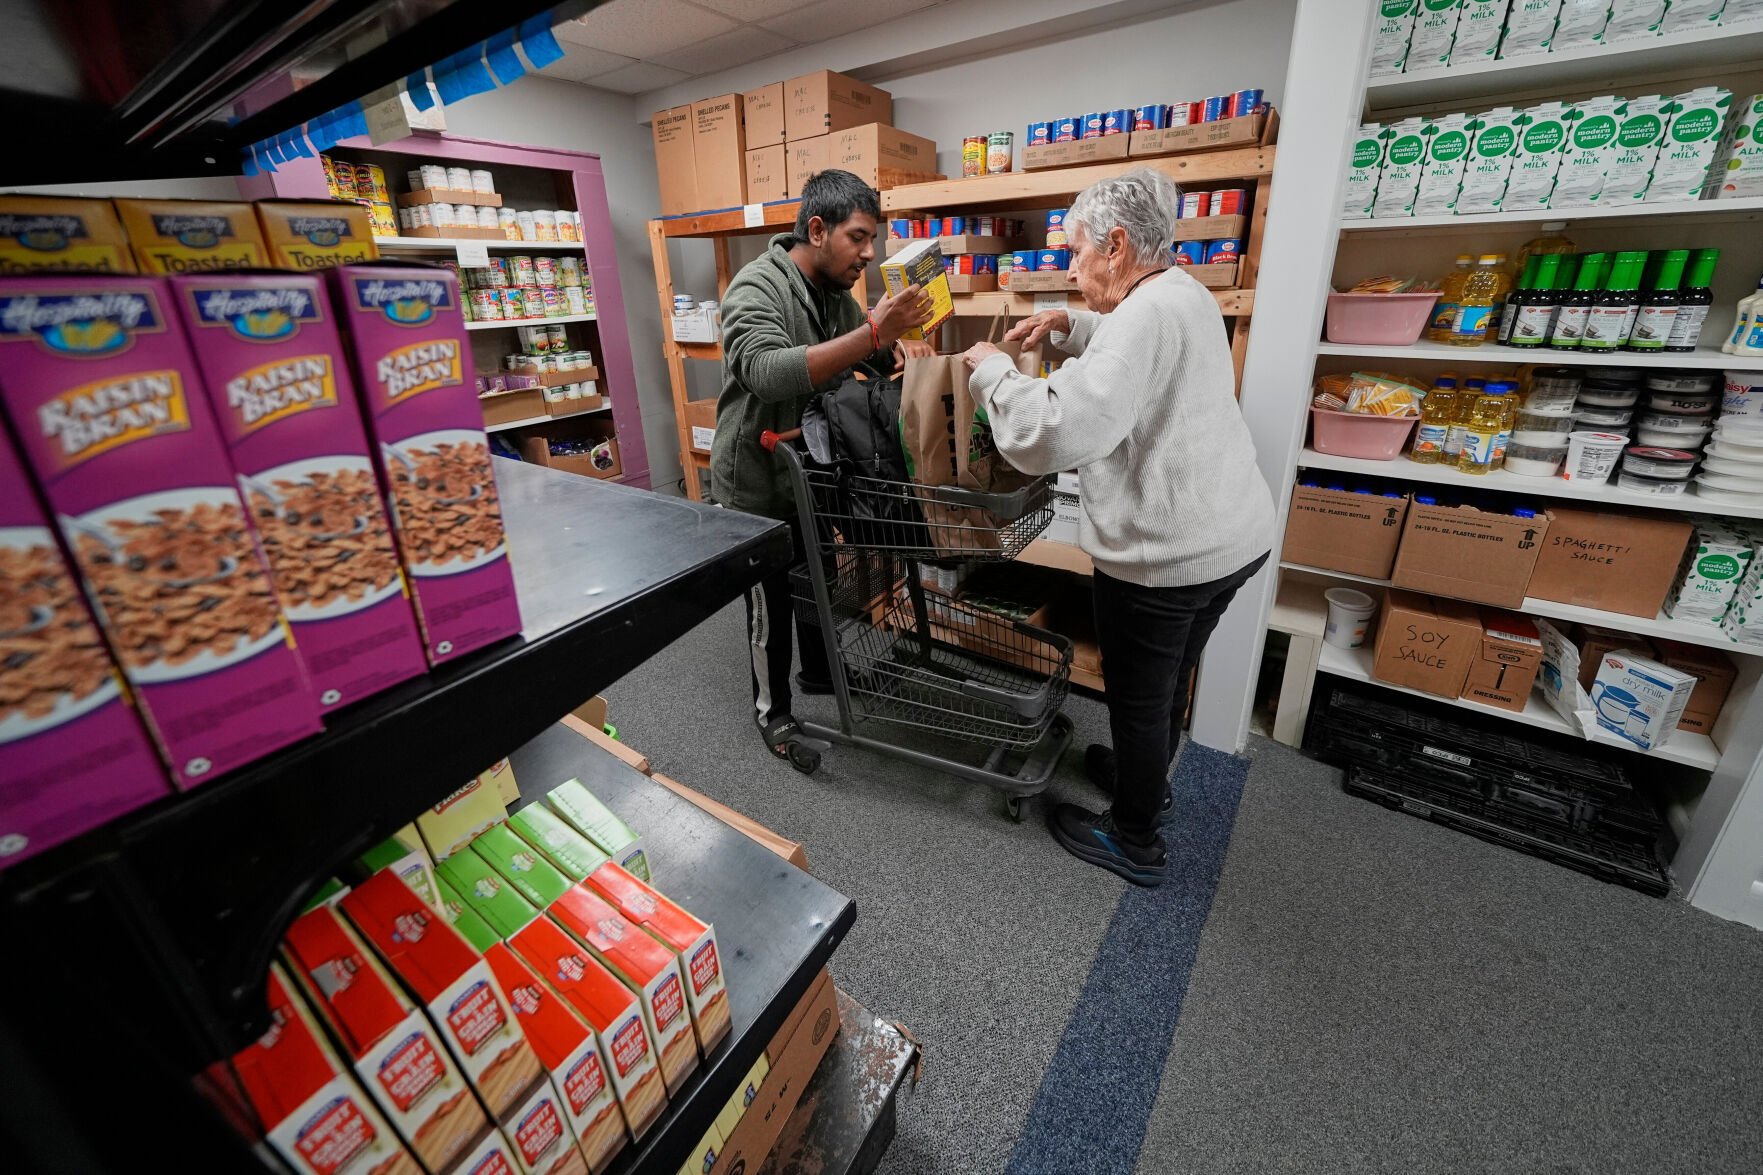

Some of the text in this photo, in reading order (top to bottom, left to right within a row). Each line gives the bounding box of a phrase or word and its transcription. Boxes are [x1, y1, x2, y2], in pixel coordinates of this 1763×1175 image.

[1524, 1, 1550, 10] MILK
[1470, 10, 1496, 20] MILK
[1380, 25, 1402, 34] MILK
[1424, 19, 1448, 28] MILK
[795, 88, 807, 96] MAC
[698, 103, 730, 116] SHELLED PECANS
[1527, 132, 1558, 141] modern
[1679, 127, 1712, 135] pantry
[841, 134, 857, 144] MAC
[1480, 137, 1510, 146] modern
[1483, 142, 1510, 150] pantry
[1530, 138, 1559, 147] pantry
[797, 150, 810, 160] MAC
[1395, 150, 1418, 159] pantry
[1437, 146, 1463, 155] pantry
[1671, 150, 1700, 159] MILK
[842, 154, 861, 164] CHEESE
[1523, 160, 1549, 168] MILK
[1573, 157, 1600, 165] MILK
[1617, 155, 1644, 164] MILK
[1431, 168, 1454, 176] MILK
[1476, 164, 1501, 172] MILK
[1350, 174, 1370, 182] MILK
[1390, 171, 1411, 180] MILK
[154, 252, 254, 272] Toasted
[289, 250, 366, 270] Toasted
[362, 278, 448, 304] Hospitality
[200, 288, 311, 318] Hospitality
[377, 341, 456, 384] RAISIN
[227, 357, 328, 408] RAISIN
[387, 360, 453, 398] BRAN
[38, 374, 176, 438] RAISIN
[242, 378, 323, 424] BRAN
[62, 401, 170, 457] BRAN
[1383, 518, 1397, 527] UP
[1477, 534, 1504, 542] BOTTLES
[1518, 540, 1535, 550] UP
[1552, 536, 1631, 554] SPAGHETTI
[1571, 551, 1614, 565] SAUCE
[1700, 562, 1734, 571] modern
[1704, 567, 1734, 576] pantry
[1695, 584, 1723, 594] MILK
[1406, 625, 1449, 649] SOY
[1392, 646, 1447, 669] SAUCE
[1622, 676, 1666, 700] dry milk
[1474, 689, 1512, 703] DRESSING
[692, 942, 713, 973] FRUIT
[693, 953, 714, 983] GRAIN
[654, 974, 677, 1008] FRUIT
[450, 984, 491, 1027] FRUIT
[656, 987, 680, 1020] GRAIN
[457, 998, 498, 1040] GRAIN
[613, 1016, 640, 1054] FRUIT
[616, 1028, 643, 1066] GRAIN
[381, 1037, 428, 1084] FRUIT
[389, 1048, 437, 1097] GRAIN
[567, 1055, 596, 1091] FRUIT
[570, 1064, 600, 1103] GRAIN
[298, 1101, 354, 1152] FRUIT
[517, 1102, 551, 1142] FRUIT
[308, 1113, 364, 1165] GRAIN
[522, 1112, 556, 1153] GRAIN
